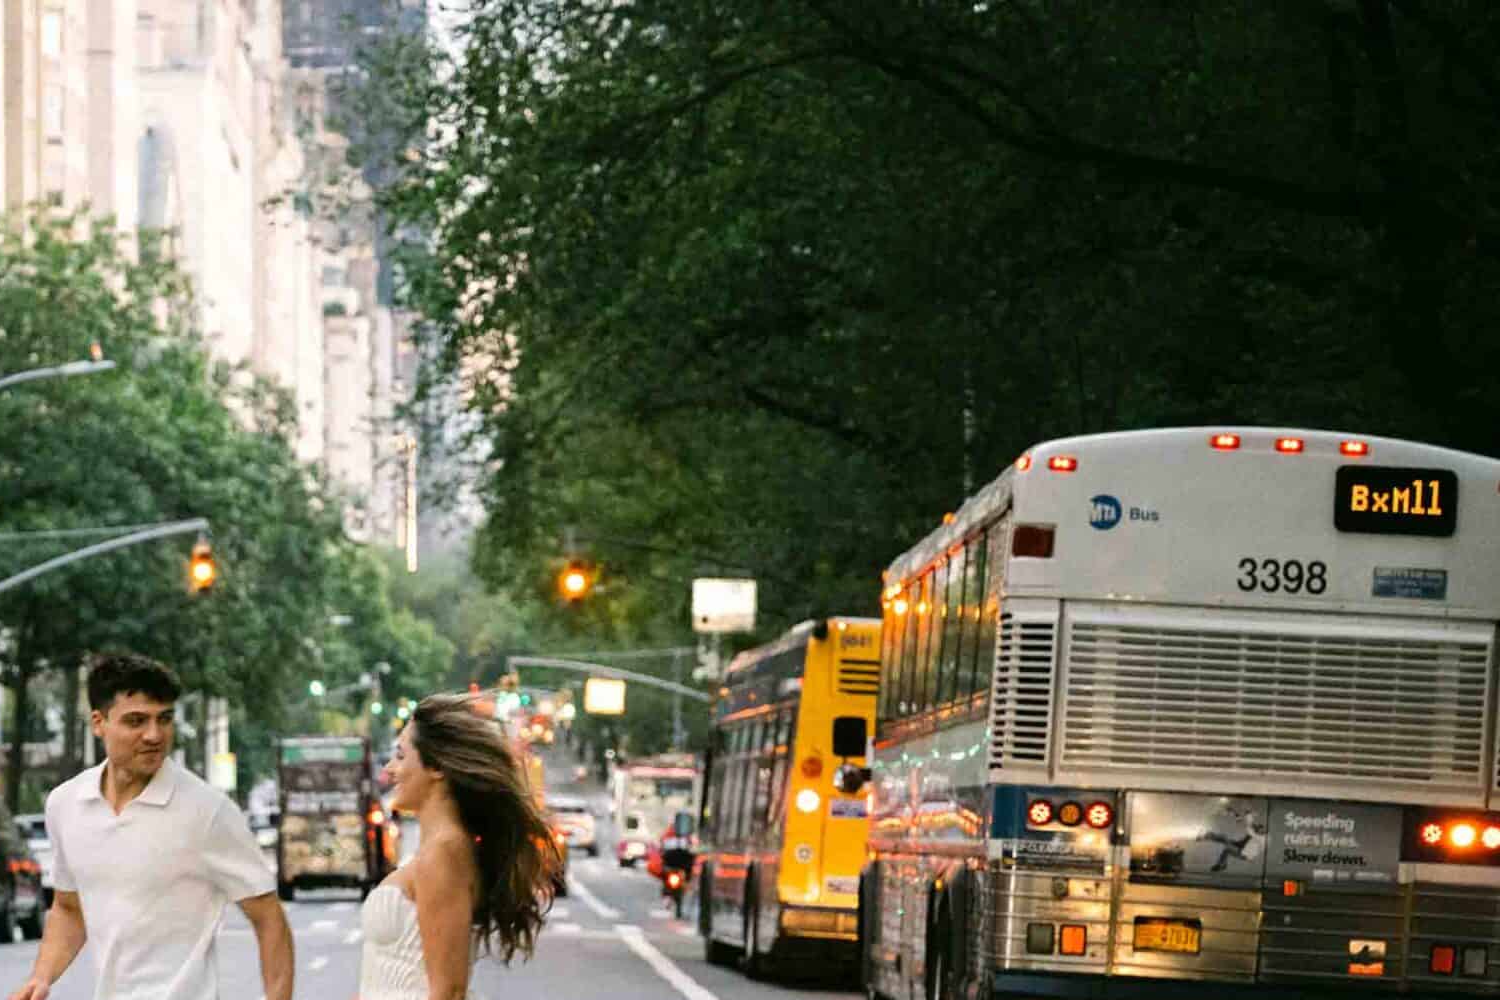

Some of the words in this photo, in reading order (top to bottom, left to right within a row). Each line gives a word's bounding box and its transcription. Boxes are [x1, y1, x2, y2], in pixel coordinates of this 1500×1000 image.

[1351, 480, 1442, 515] BxM11
[1129, 507, 1159, 521] Bus
[1237, 557, 1327, 595] 3398
[1283, 811, 1355, 833] Speeding
[1323, 832, 1358, 849] lives.
[1283, 848, 1319, 863] Slow
[1322, 850, 1367, 866] down.
